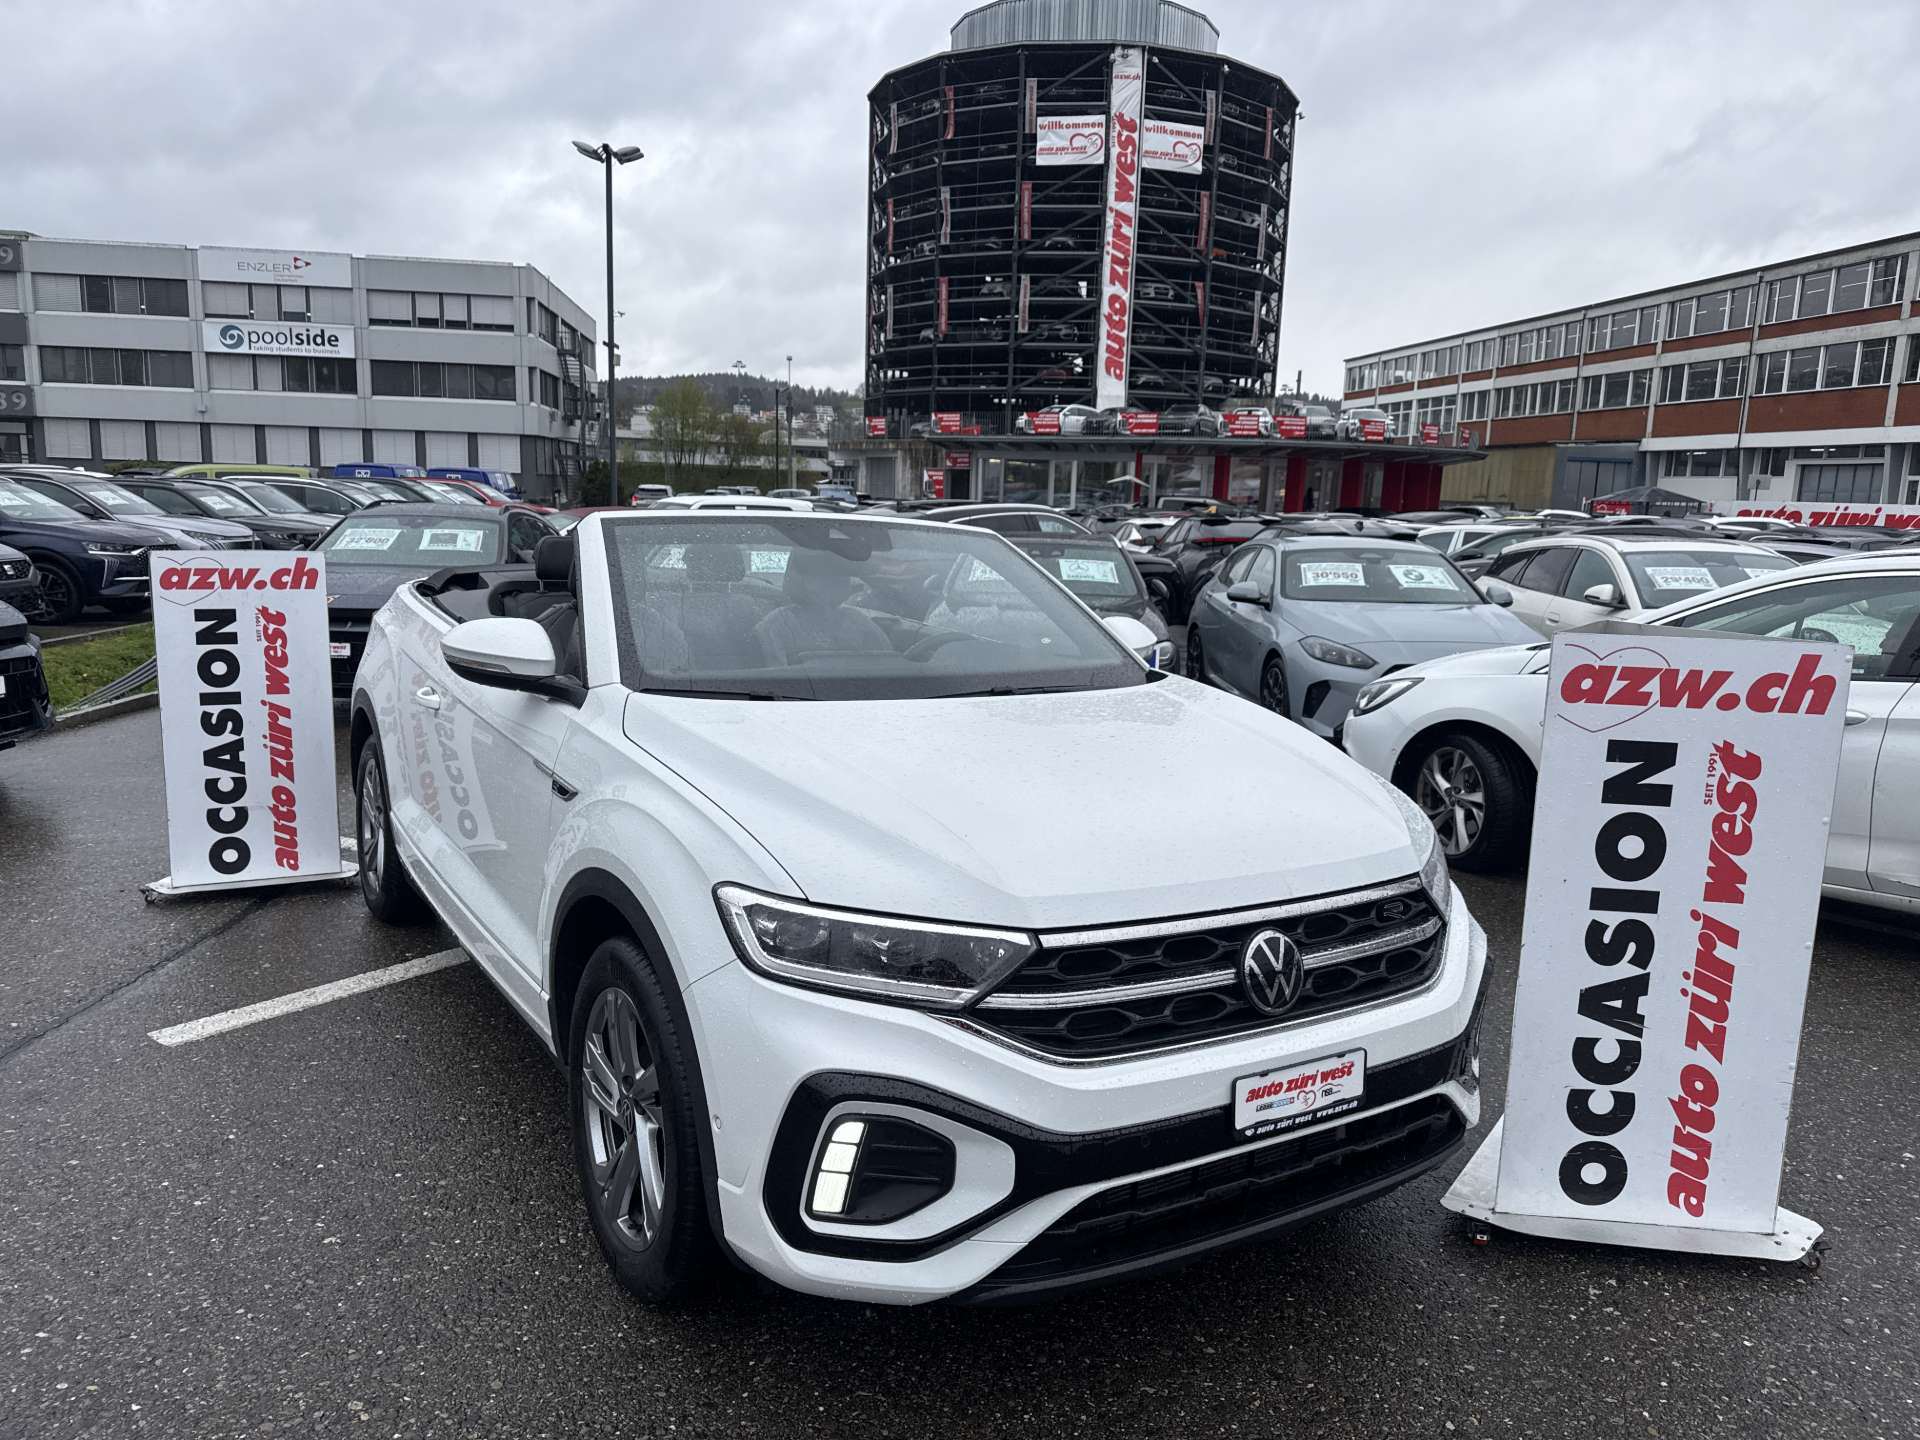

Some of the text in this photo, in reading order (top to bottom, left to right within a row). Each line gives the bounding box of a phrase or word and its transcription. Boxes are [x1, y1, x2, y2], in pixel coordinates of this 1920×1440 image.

[1038, 120, 1104, 131] willkommen
[1144, 125, 1203, 139] willkommen
[237, 261, 292, 273] ENZLER
[1103, 111, 1138, 382] auto züri west
[247, 327, 340, 351] poolside
[253, 345, 341, 355] taking students to business
[159, 557, 320, 591] azw.ch
[1560, 654, 1838, 716] azw.ch
[193, 607, 251, 875] OCCASION
[256, 605, 299, 872] auto züri west
[1703, 752, 1718, 806] SEIT 1991
[1558, 738, 1680, 1208] OCCASION
[1667, 739, 1764, 1219] auto züri west
[1245, 1080, 1284, 1104] auto
[1283, 1068, 1320, 1093] züri
[1320, 1060, 1355, 1084] west
[1256, 1100, 1358, 1134] auto züri west www.azw.ch
